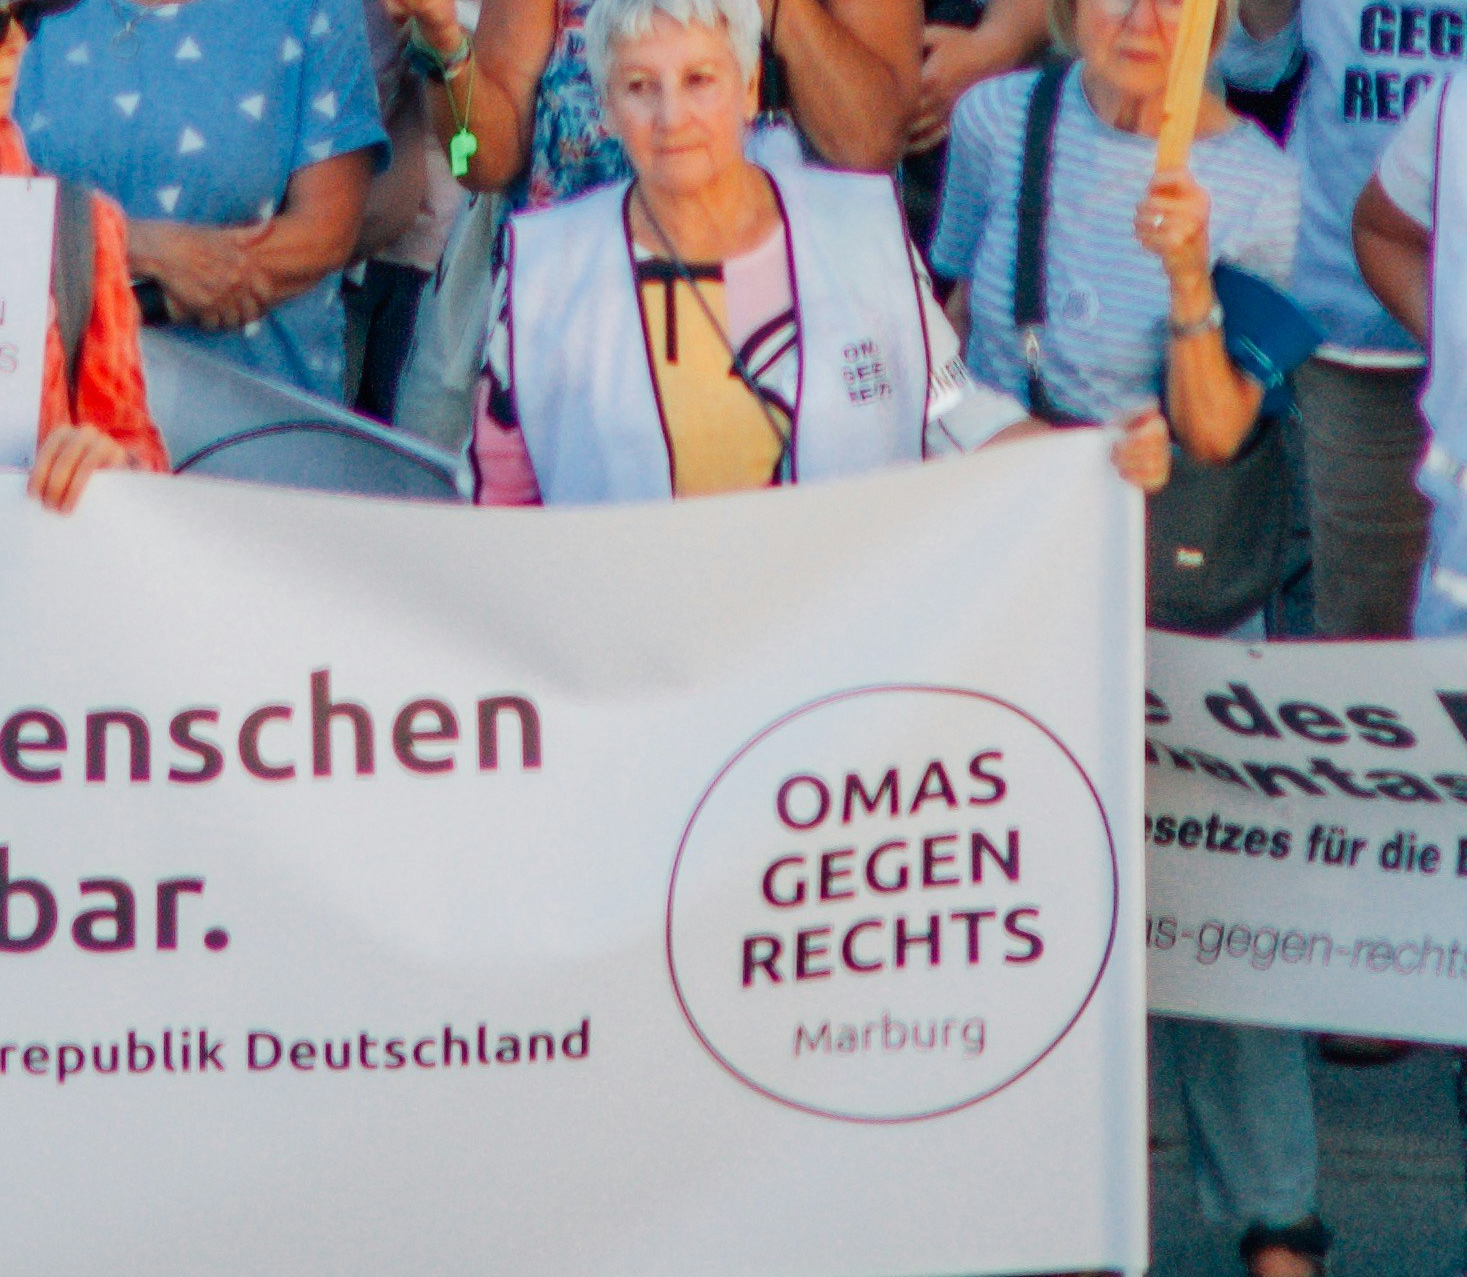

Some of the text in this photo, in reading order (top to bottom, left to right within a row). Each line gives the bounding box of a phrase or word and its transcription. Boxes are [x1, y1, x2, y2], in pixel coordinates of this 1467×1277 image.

[1203, 680, 1418, 749] des
[775, 750, 1008, 831] OMAS
[761, 828, 1021, 909] GEGEN
[1306, 824, 1369, 869] für
[1378, 830, 1442, 876] die
[741, 905, 1045, 988] RECHTS
[246, 1013, 593, 1074] Deutschland
[792, 1010, 988, 1058] Marburg
